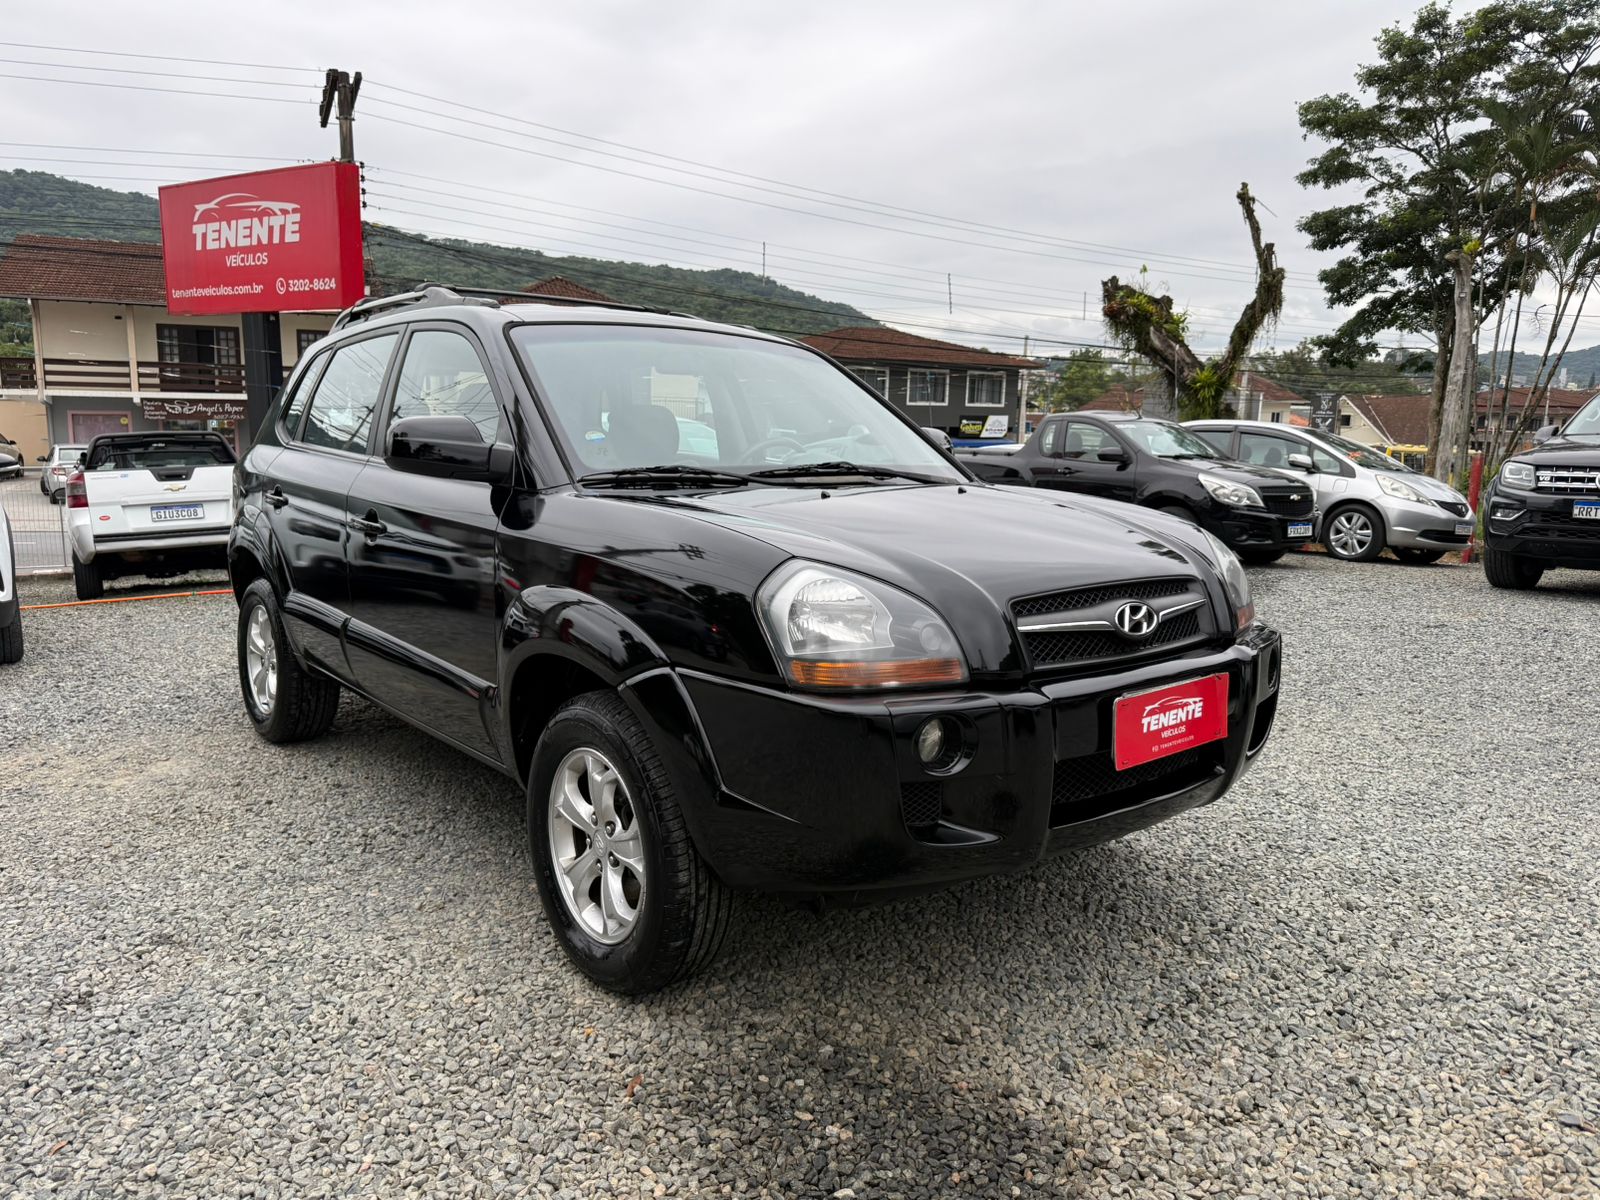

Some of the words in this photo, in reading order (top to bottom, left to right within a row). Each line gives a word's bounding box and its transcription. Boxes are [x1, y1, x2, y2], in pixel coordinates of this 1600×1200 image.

[192, 213, 300, 251] TENENTE
[225, 252, 268, 267] VEÍCULOS
[172, 282, 264, 298] tenenteveiculos.com.br
[288, 277, 336, 291] 3202-8624
[196, 403, 223, 416] Angel's
[224, 403, 244, 414] Paper
[155, 509, 199, 519] GIU3C08
[1141, 702, 1203, 733] TENENTE
[1161, 725, 1186, 738] VEÍCULOS
